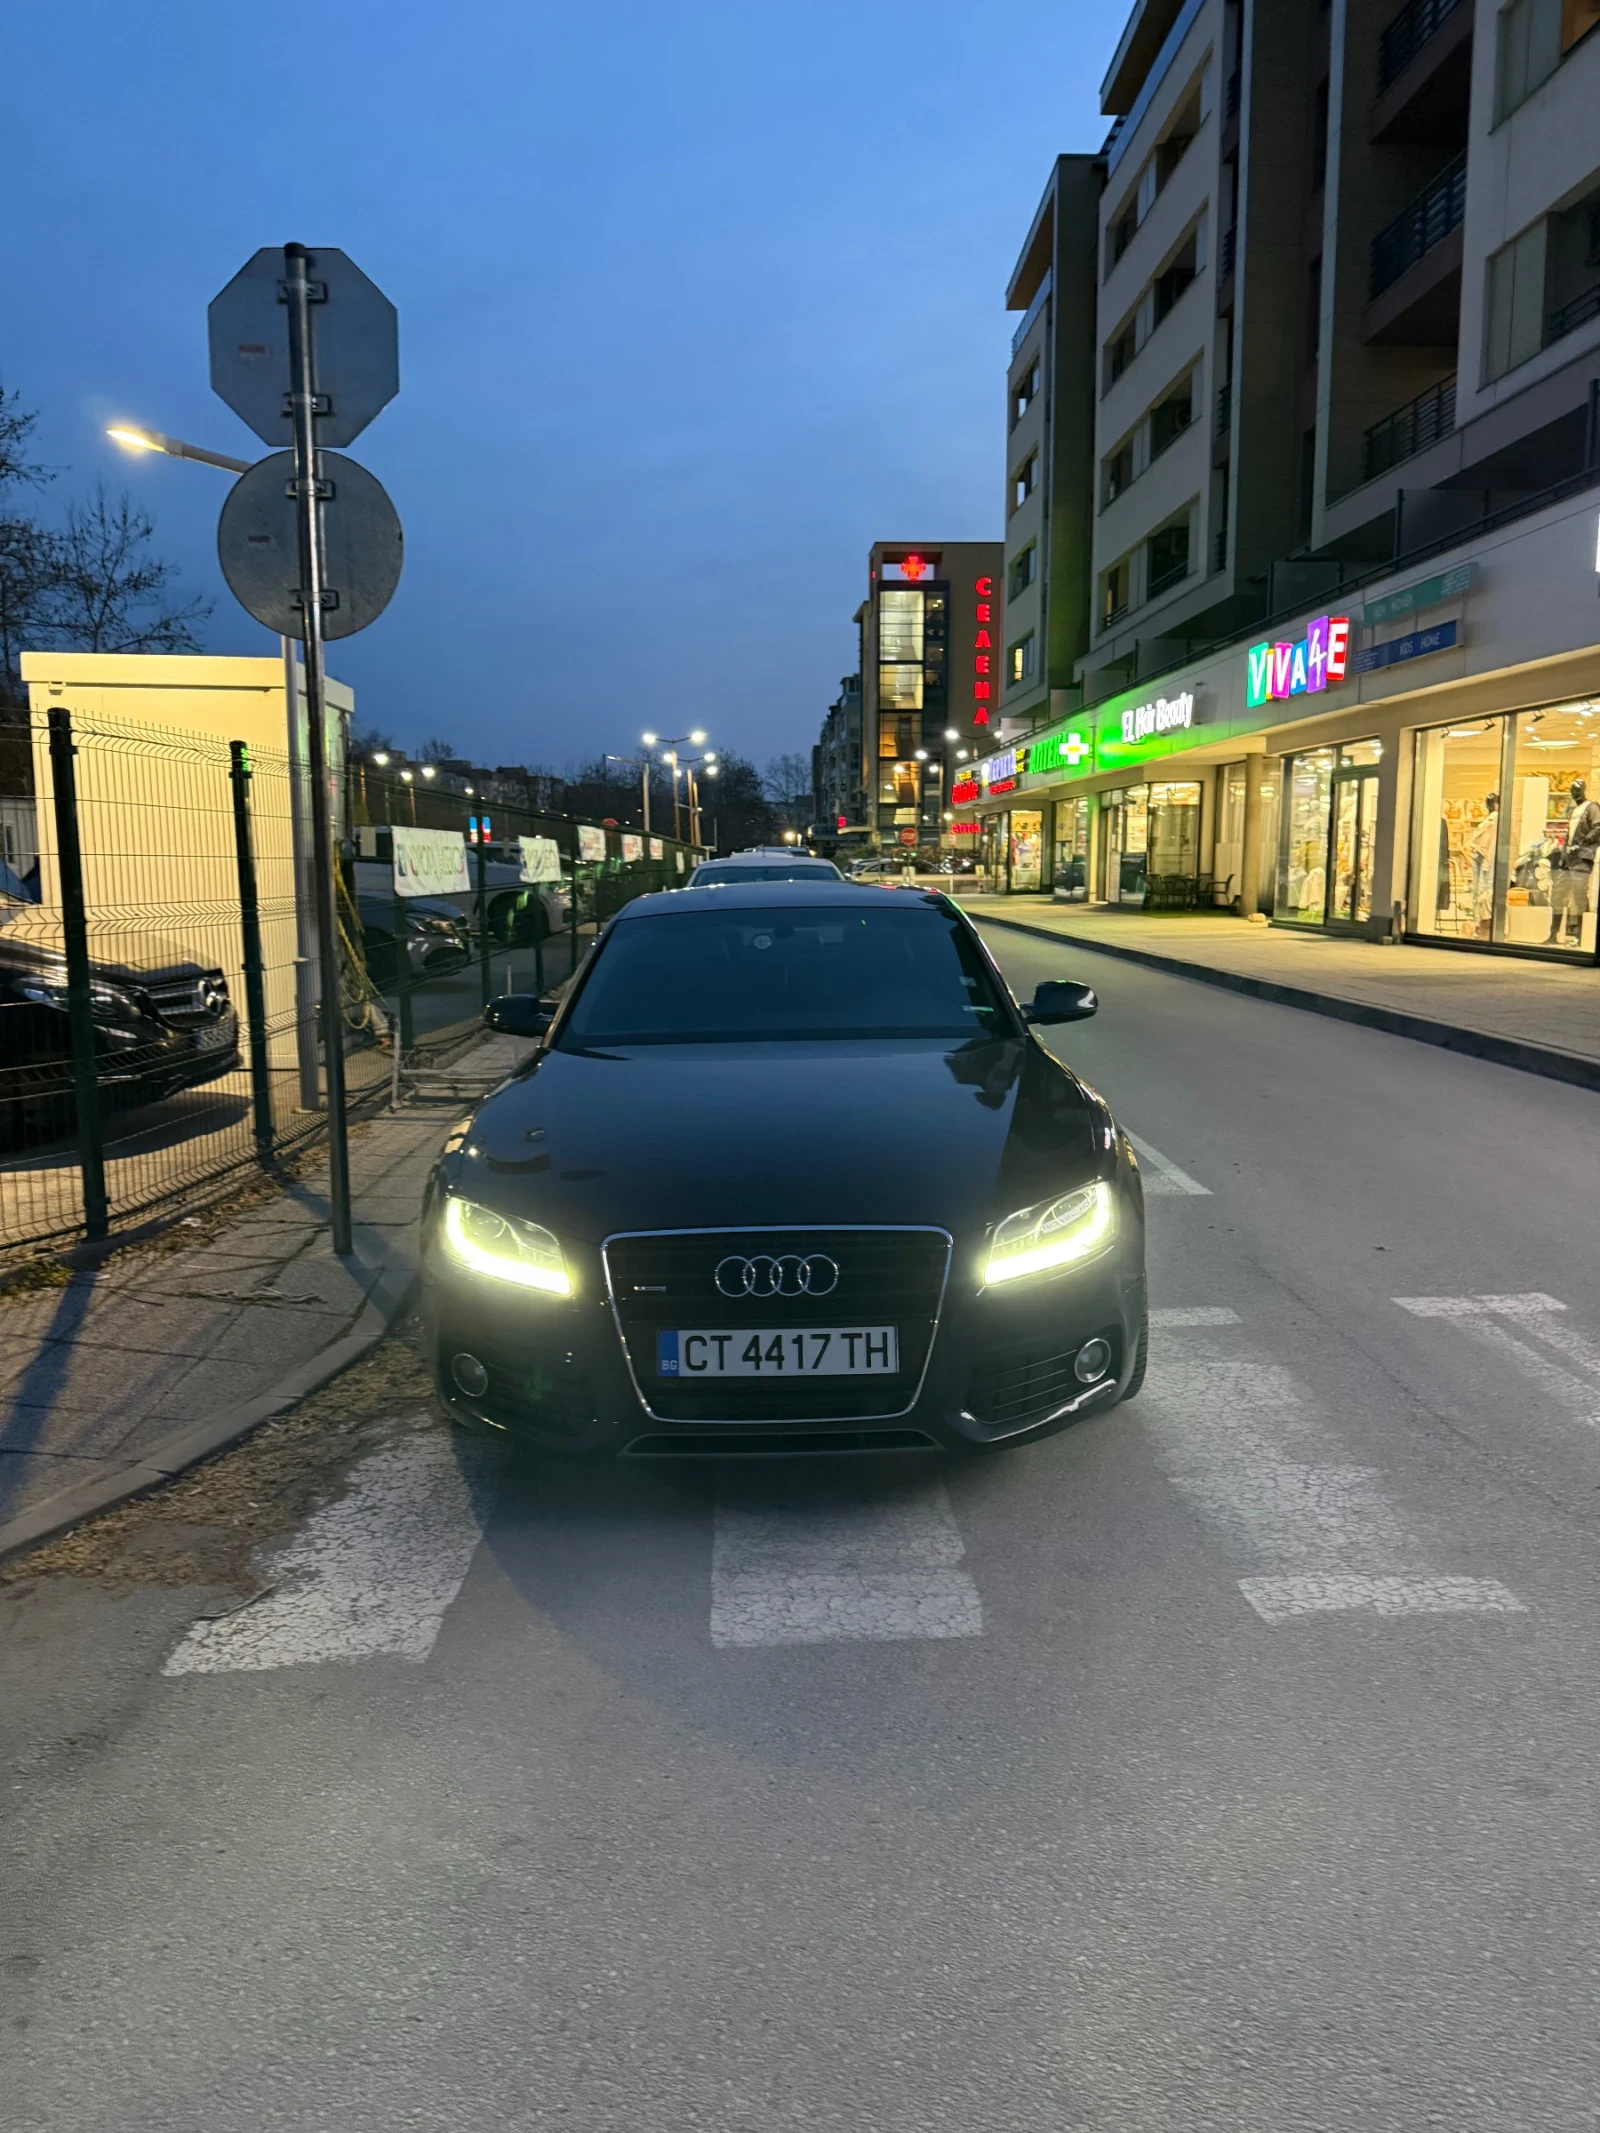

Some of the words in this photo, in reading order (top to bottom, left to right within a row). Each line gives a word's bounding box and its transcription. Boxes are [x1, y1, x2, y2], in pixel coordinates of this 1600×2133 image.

[1247, 616, 1349, 707] VIVA4E
[1400, 641, 1413, 656] KIDS
[1421, 632, 1441, 649] HOME
[1136, 703, 1155, 739] Hair
[1156, 692, 1193, 729] Beauty
[901, 831, 917, 842] STOP
[661, 1359, 678, 1371] BG
[685, 1335, 732, 1371] CT
[742, 1334, 832, 1371] 4417
[841, 1332, 889, 1369] TH
